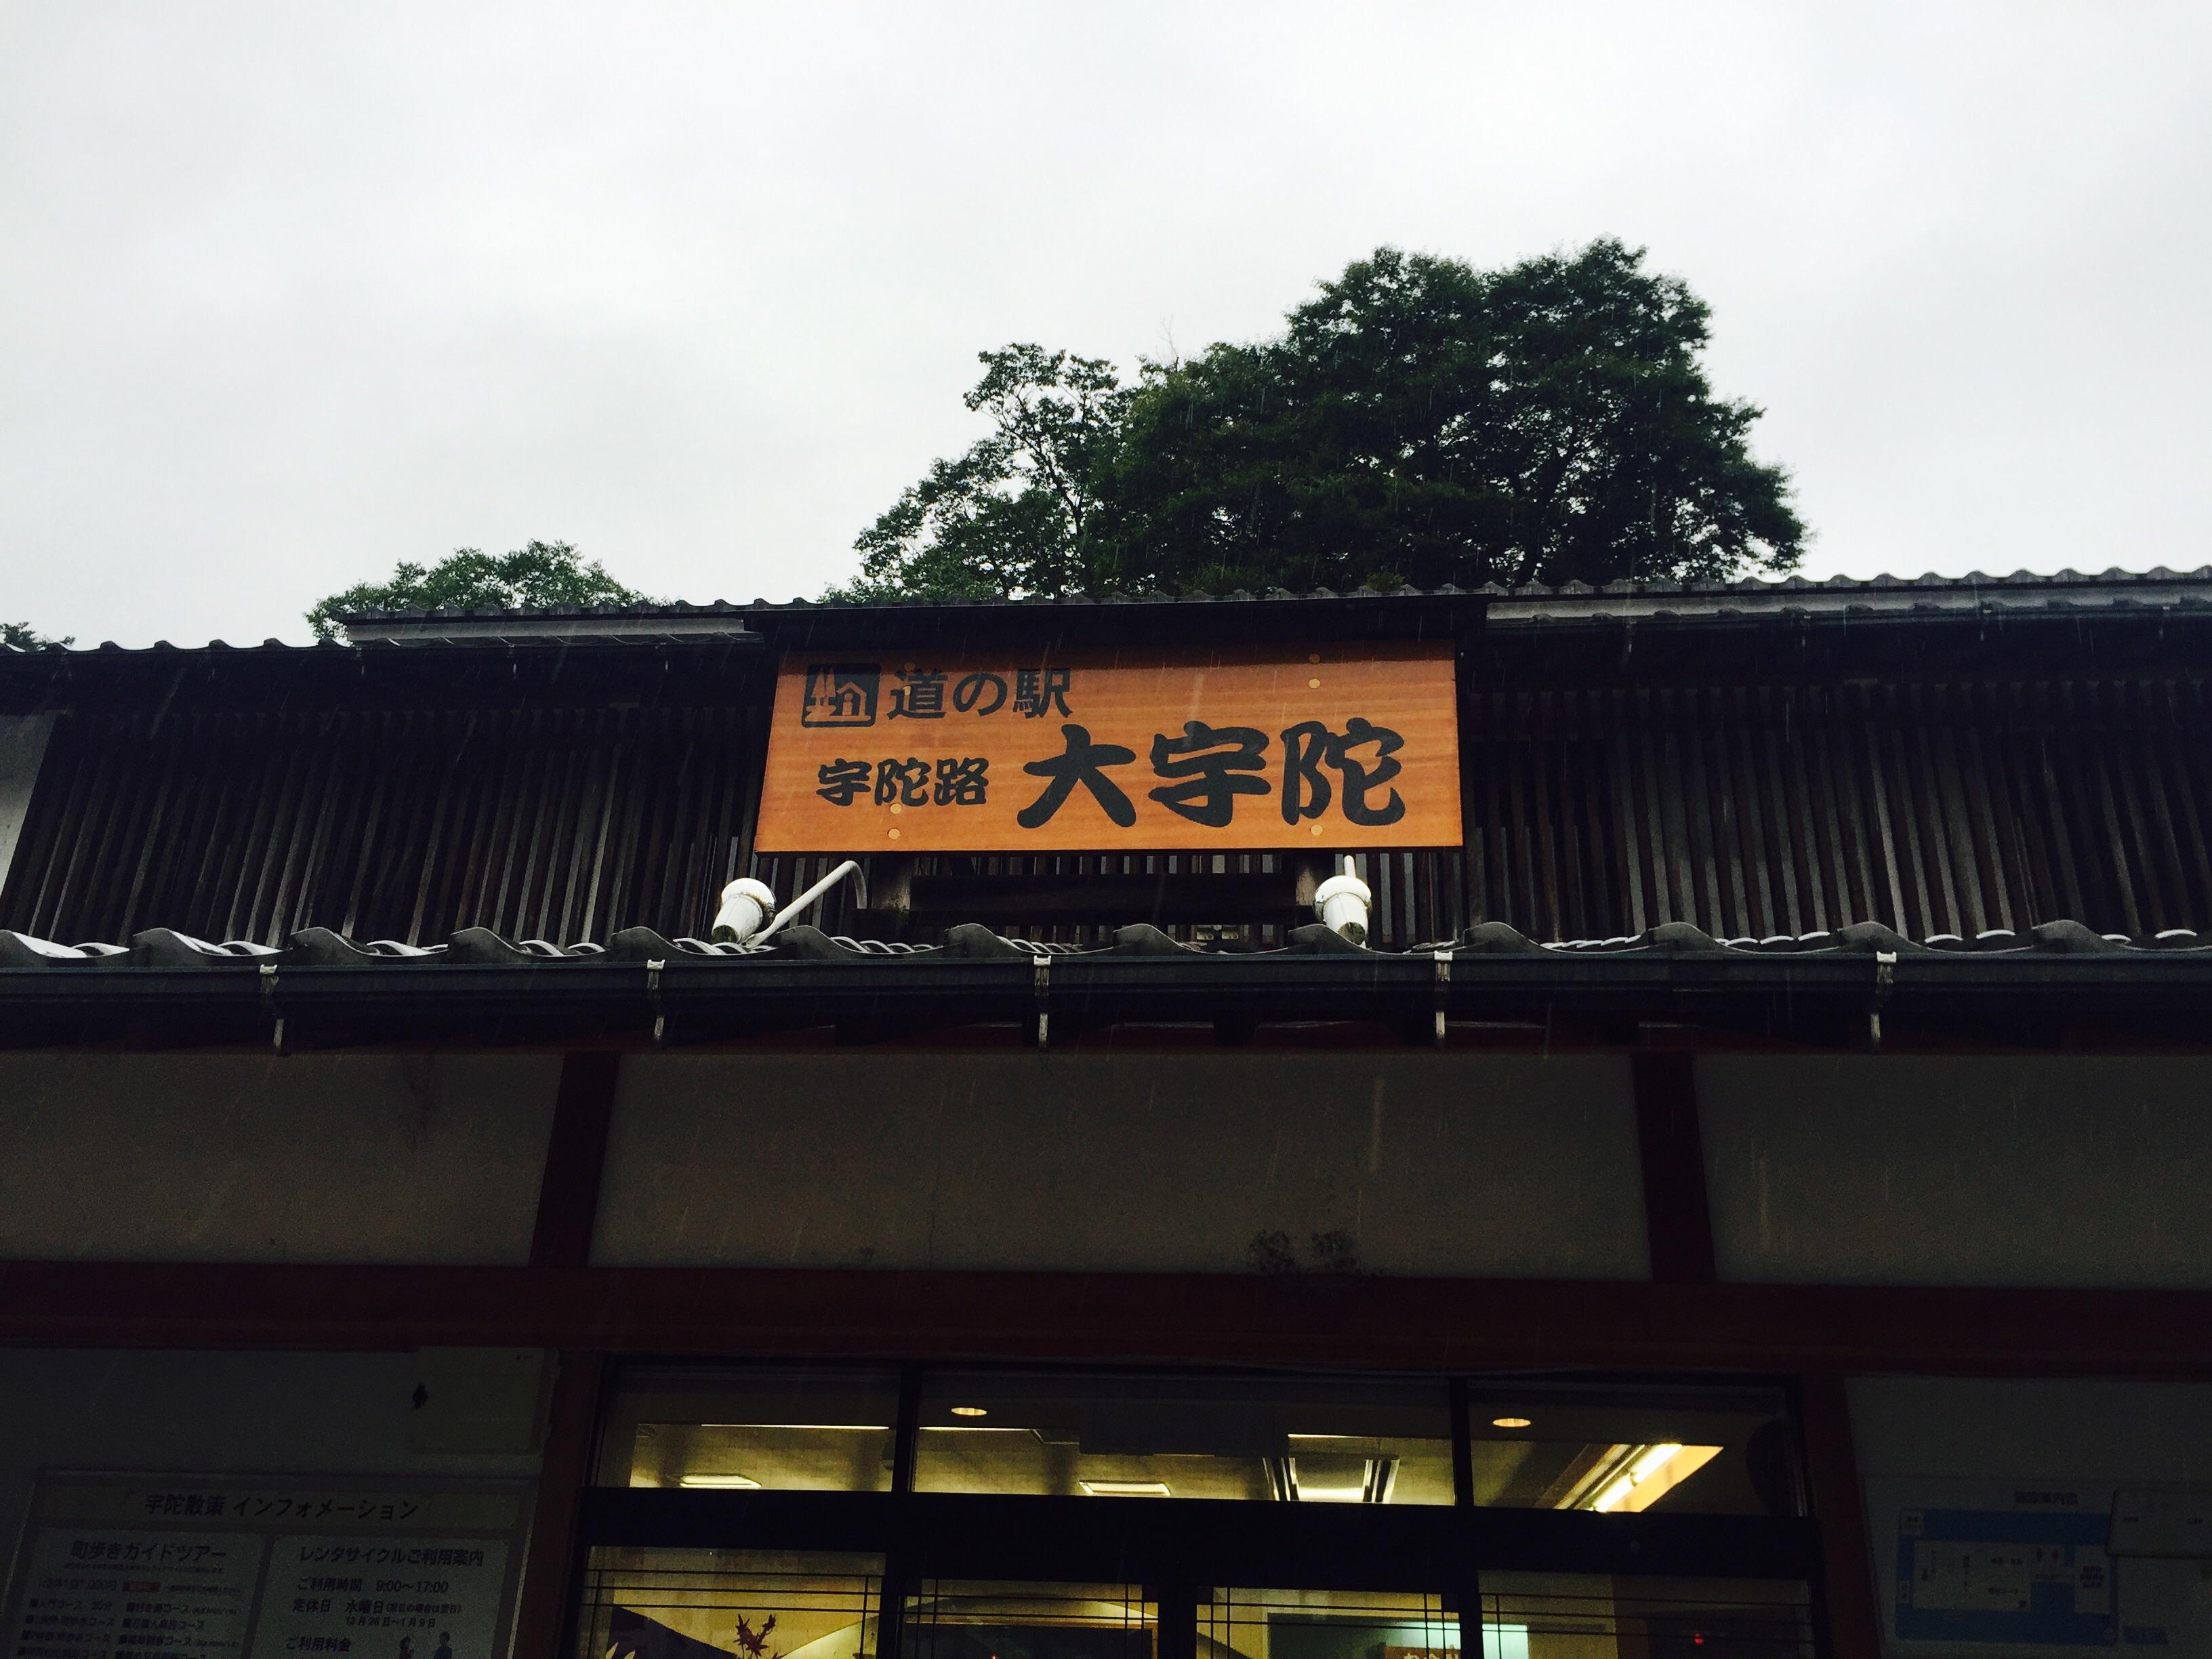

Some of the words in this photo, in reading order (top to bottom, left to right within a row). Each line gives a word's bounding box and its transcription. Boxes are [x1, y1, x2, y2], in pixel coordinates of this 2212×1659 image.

[888, 669, 1073, 718] 道の駅
[817, 756, 989, 808] 宇陀路
[1017, 717, 1405, 829] 大宇陀
[145, 1494, 225, 1517] 宇陀散策
[234, 1496, 418, 1520] インフォメーション
[71, 1540, 226, 1562] 町歩きガイドツアー
[300, 1546, 484, 1567] レンタサイクルご利用案内
[298, 1577, 362, 1593] ご利用時間
[293, 1598, 331, 1613] 定休日
[285, 1636, 351, 1652] ご利用料金
